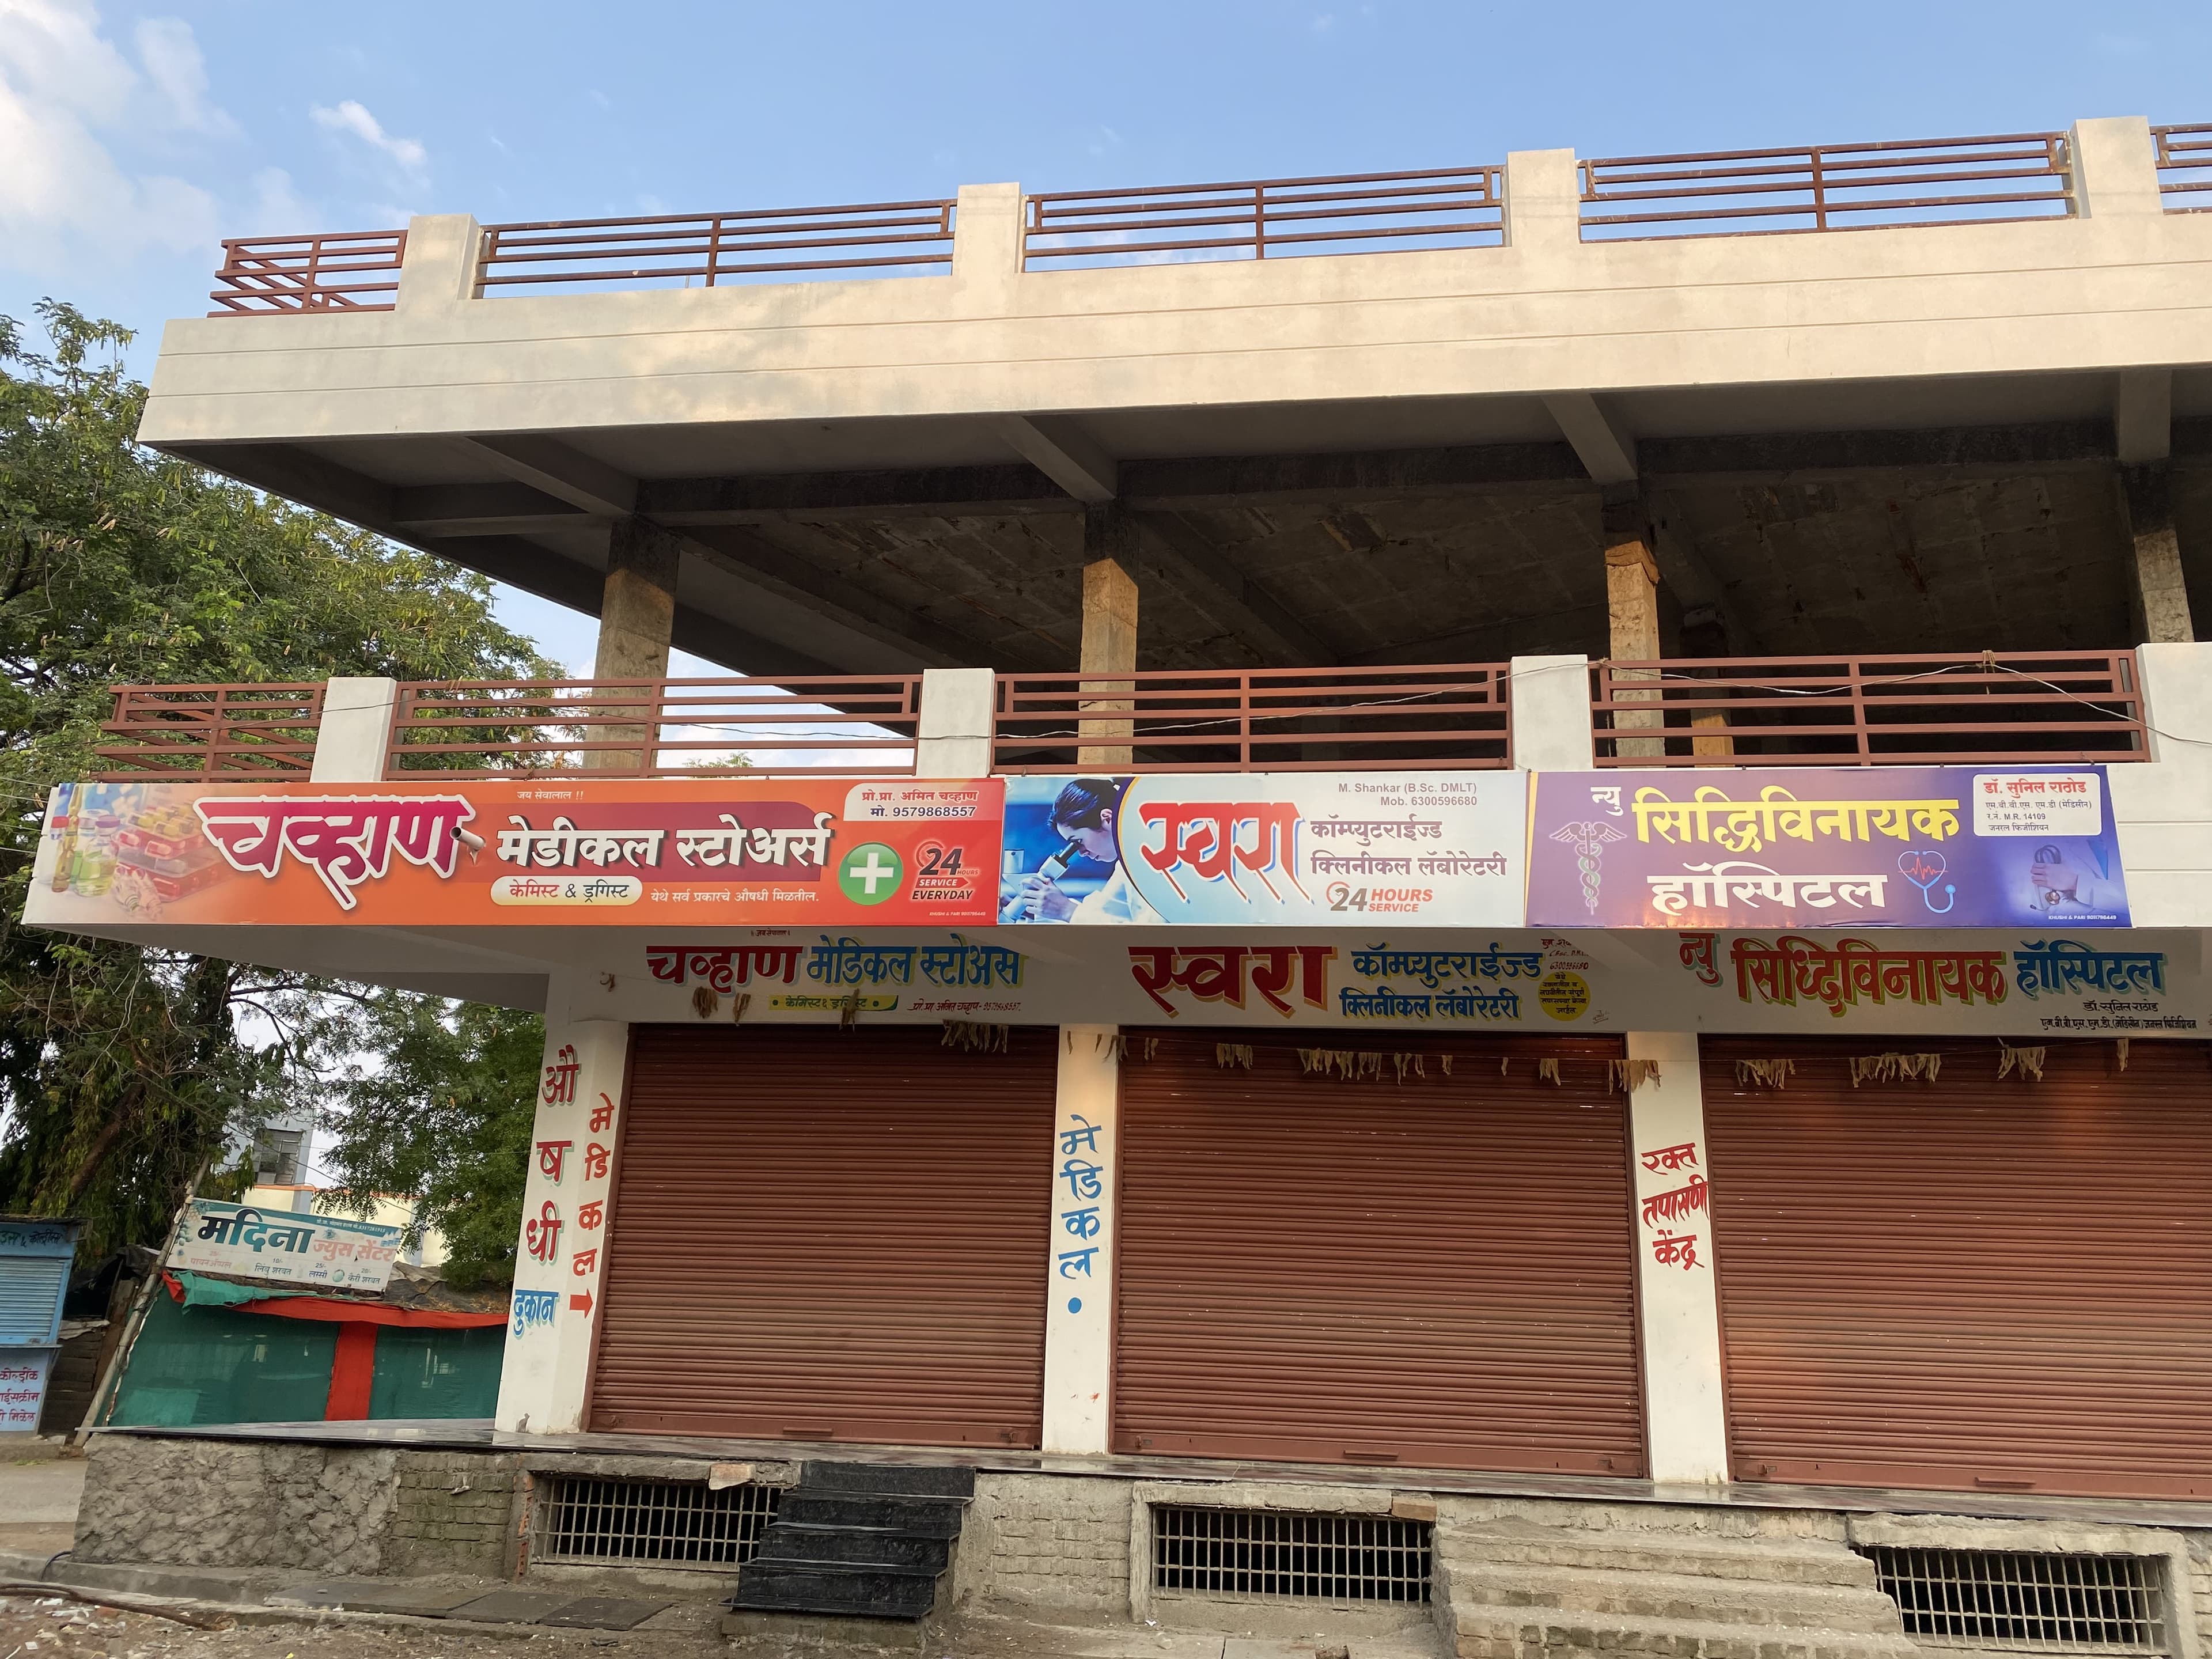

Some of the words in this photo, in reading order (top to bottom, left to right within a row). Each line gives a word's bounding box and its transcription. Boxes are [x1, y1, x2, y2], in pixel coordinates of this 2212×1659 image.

[517, 790, 532, 800] जय
[535, 789, 571, 800] सेवालाल
[901, 789, 935, 801] अमित
[938, 790, 979, 803] चव्हाण
[1339, 783, 1351, 793] M.
[1355, 783, 1400, 793] Shankar
[1404, 783, 1437, 794] (B.Sc.
[1441, 783, 1477, 793] DMLT)
[1380, 796, 1408, 806] Mob.
[1411, 796, 1477, 806] 6300596680
[1590, 786, 1623, 816] न्यु
[1983, 778, 2002, 794] डॉ.
[2006, 778, 2045, 798] सुनिल
[2048, 778, 2086, 793] राठोड
[870, 805, 888, 817] मो.
[893, 806, 976, 817] 9579868557
[1631, 785, 1960, 853] सिद्धिविनायक
[1310, 813, 1442, 846] कॉम्प्युटराईज्ड
[2012, 822, 2049, 831] फिजीशियन
[195, 795, 475, 910] चव्हाण
[497, 815, 664, 868] मेडीकल
[676, 812, 833, 867] स्टोअर्स
[1138, 802, 1315, 904] स्वरा
[919, 848, 963, 875] 24
[1310, 850, 1412, 875] क्लिनीकल
[1417, 850, 1507, 876] लॅबोरेटरी
[509, 879, 559, 898] केमिस्ट
[565, 884, 576, 898] &
[583, 879, 629, 903] ड्रगिस्ट
[651, 888, 669, 903] येथे
[672, 888, 690, 903] सर्व
[694, 888, 730, 903] प्रकारचे
[734, 888, 768, 902] औषधी
[772, 888, 819, 902] मिळतील.
[912, 890, 974, 899] EVERYDAY
[1330, 887, 1368, 911] 24
[1370, 889, 1433, 902] HOURS
[1647, 861, 1888, 916] हॉस्पिटल
[1368, 903, 1419, 912] SERVICE
[646, 945, 804, 994] चव्हाण
[807, 934, 918, 984] मेडिकल
[1679, 931, 1718, 983] न्यु
[2013, 940, 2167, 998] हॉस्पिटल
[1127, 946, 1334, 1014] स्वरा
[1340, 986, 1431, 1018] क्लिनीकल
[1641, 1142, 1699, 1175] रक्त
[1642, 1174, 1709, 1229] तपासणी
[198, 1207, 315, 1253] मदिना
[314, 1240, 355, 1261] ज्युस
[357, 1239, 397, 1262] सेंटर
[1653, 1229, 1705, 1270] केंद्र
[272, 1267, 292, 1275] शरबत
[309, 1270, 327, 1278] लस्सी
[362, 1276, 380, 1284] शरबत
[514, 1289, 560, 1336] दुकान
